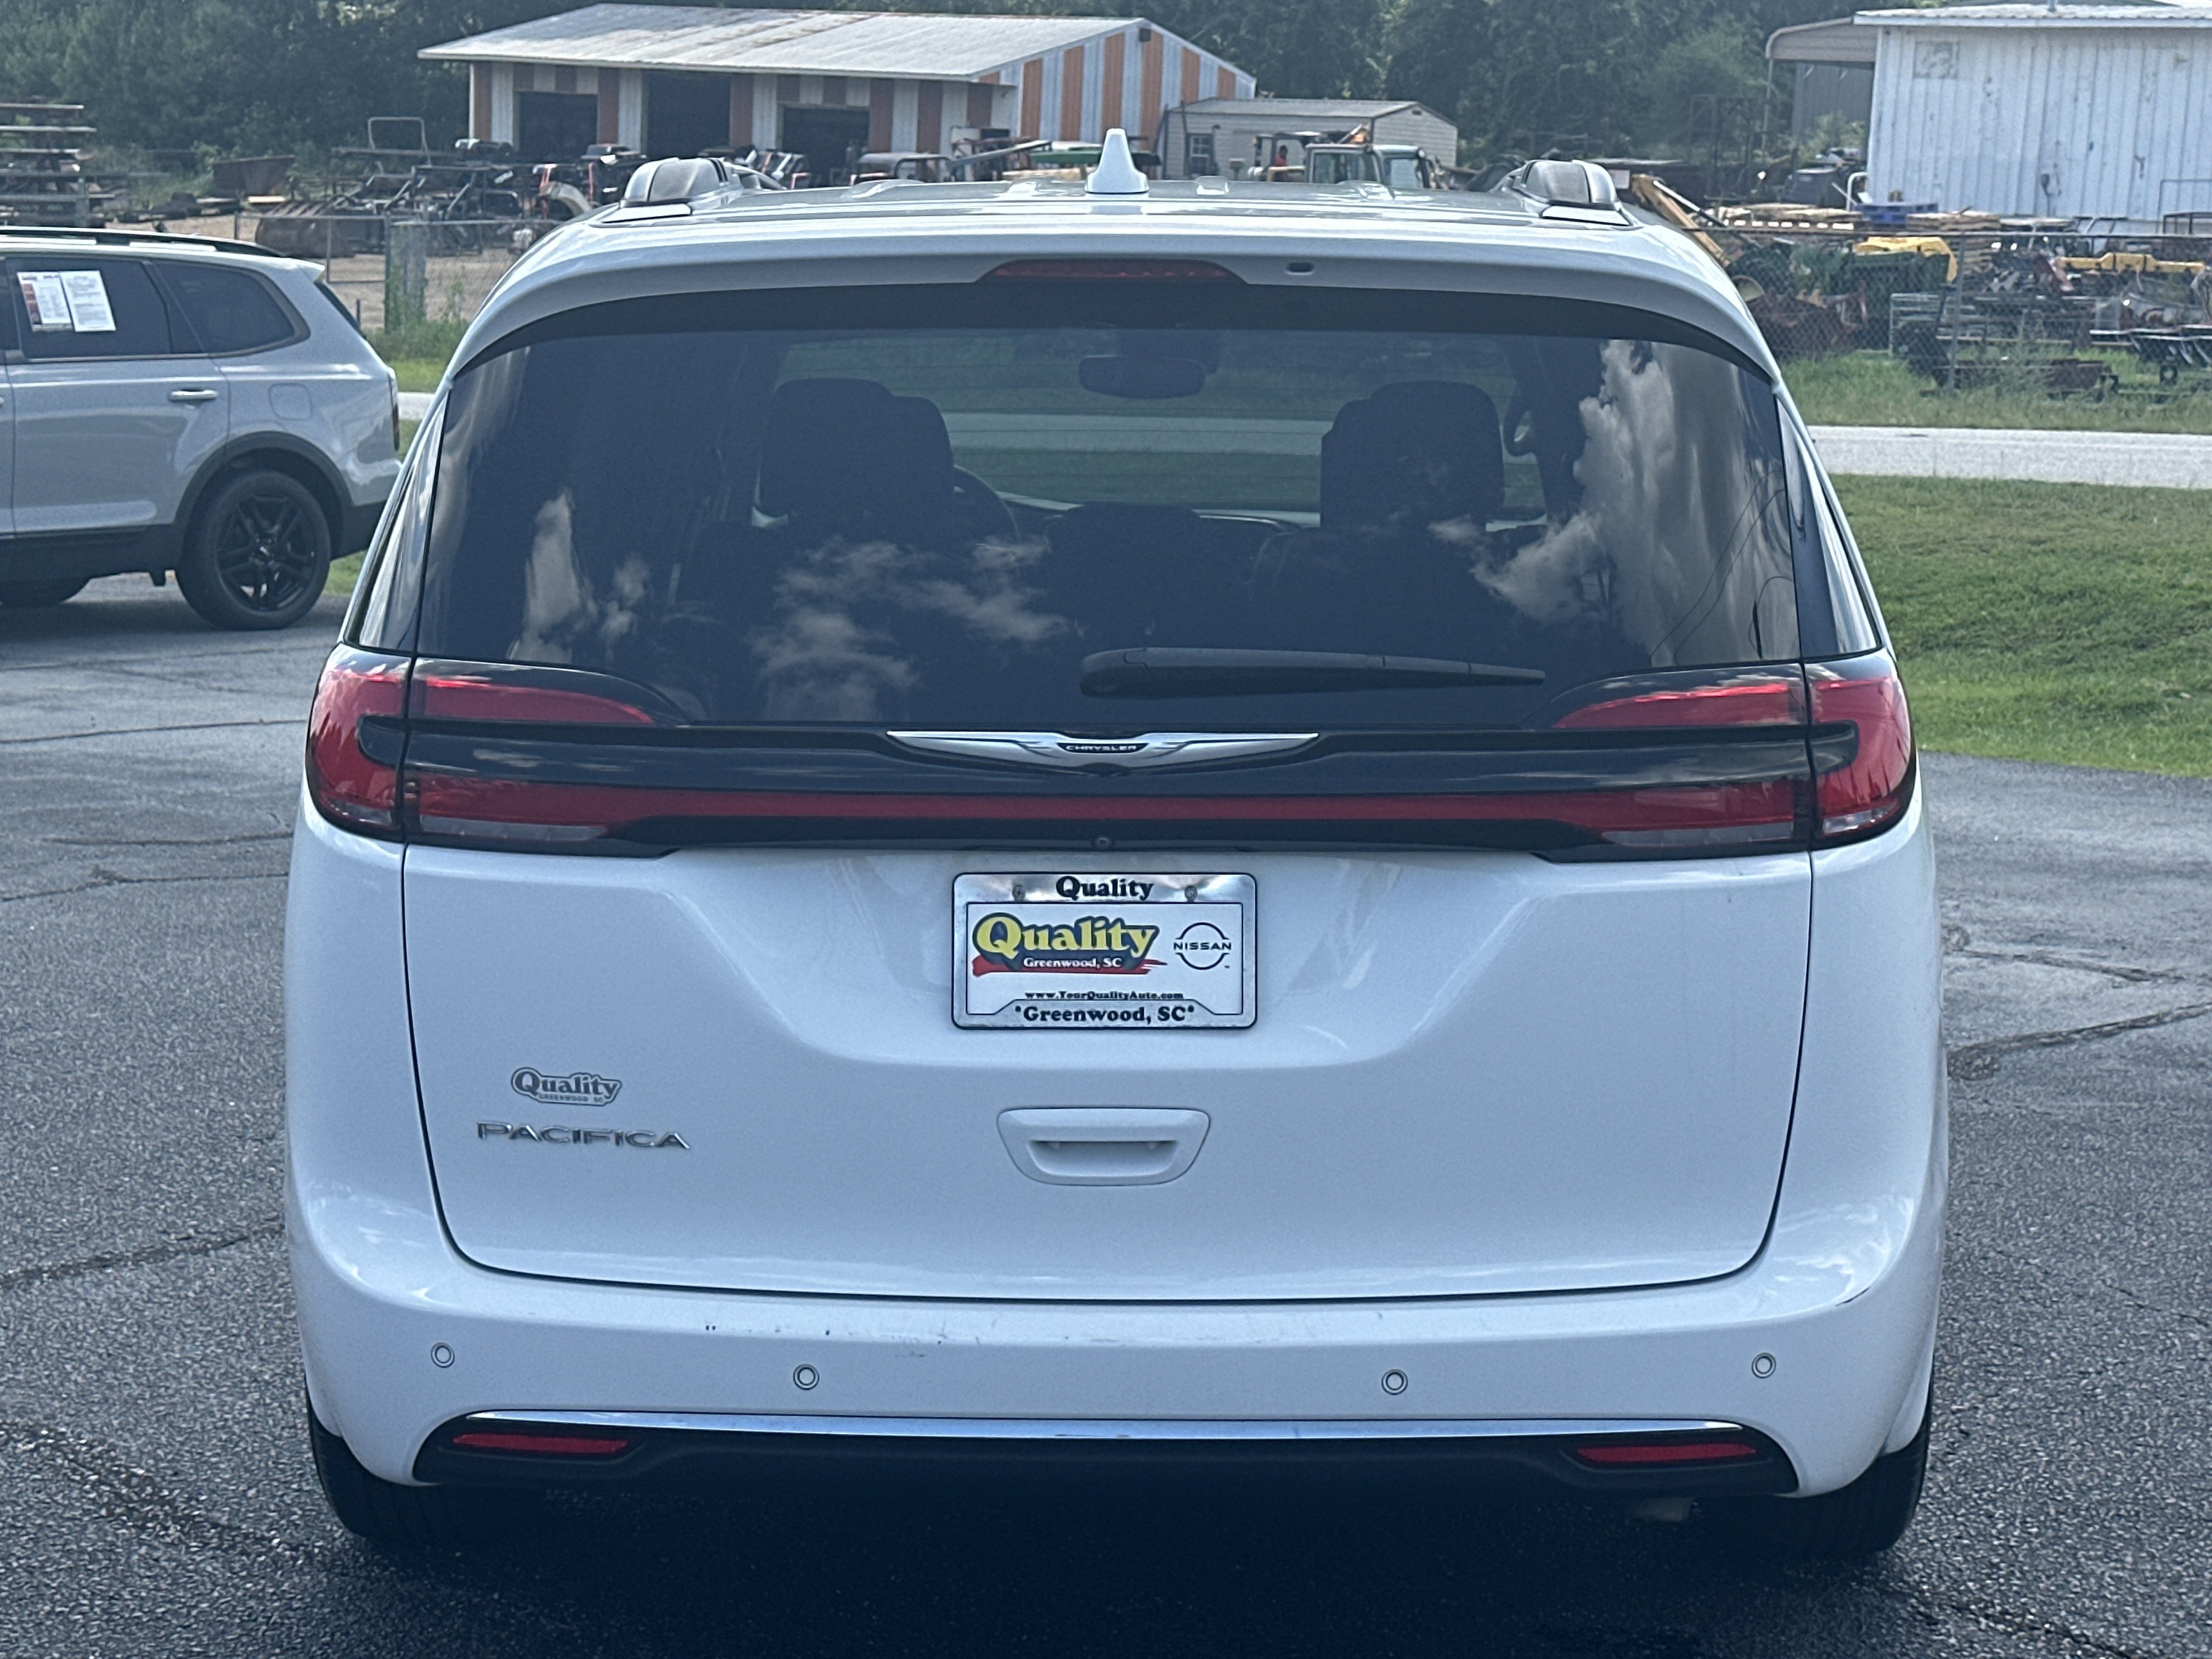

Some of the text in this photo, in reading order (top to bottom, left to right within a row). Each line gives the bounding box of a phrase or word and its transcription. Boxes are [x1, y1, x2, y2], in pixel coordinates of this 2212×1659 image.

[1056, 876, 1155, 901] Quality
[977, 916, 1156, 960] Quality
[1173, 942, 1232, 951] NISSAN
[1023, 957, 1122, 969] Greenwood, SC
[1024, 990, 1184, 1000] www.YourQualityAuto.com
[515, 1071, 618, 1098] Quality
[477, 1121, 691, 1150] PACIFICA
